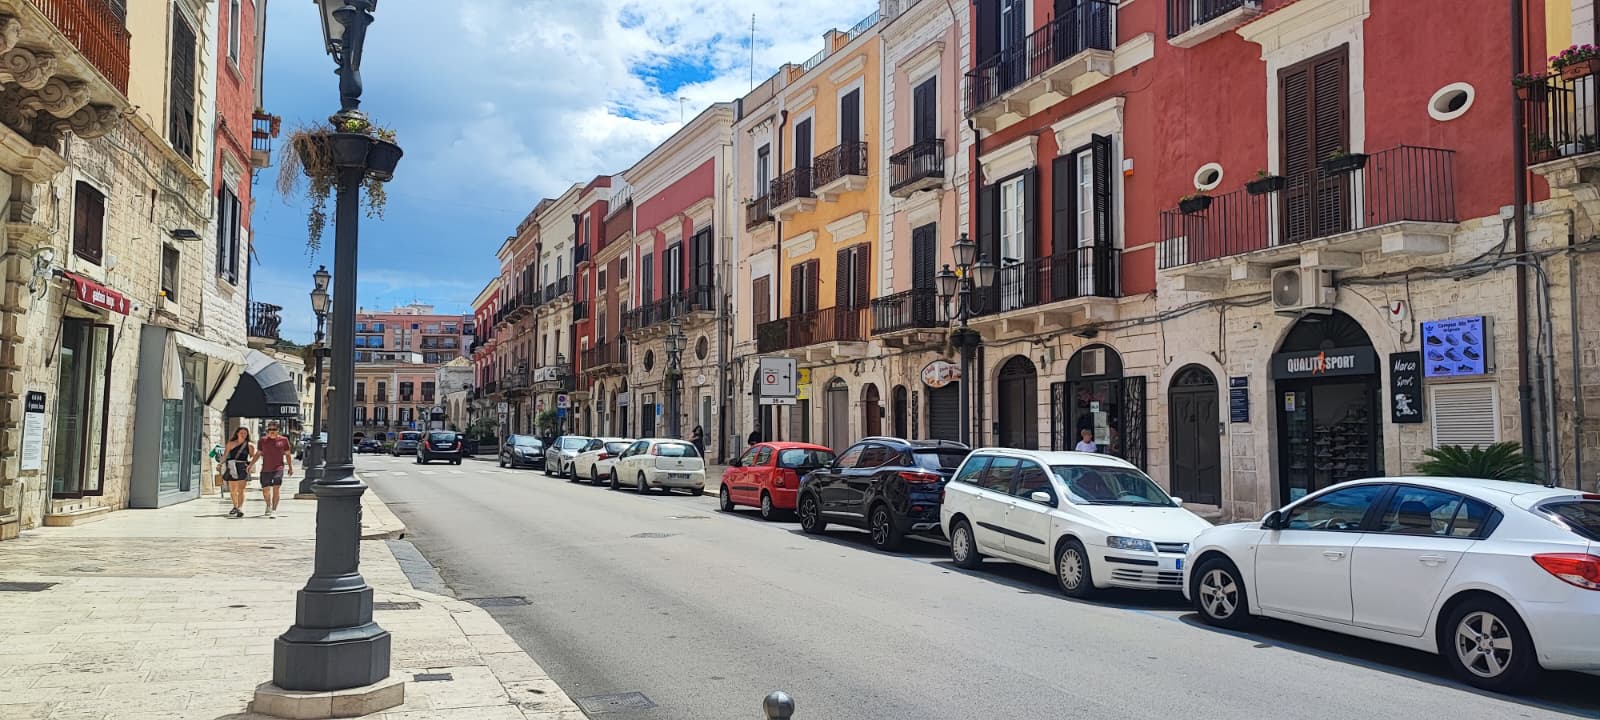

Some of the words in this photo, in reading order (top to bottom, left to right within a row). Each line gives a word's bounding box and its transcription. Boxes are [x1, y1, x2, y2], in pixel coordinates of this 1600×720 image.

[1287, 356, 1323, 373] QUALITY
[1325, 355, 1355, 370] SPORT
[1394, 360, 1416, 373] Marco
